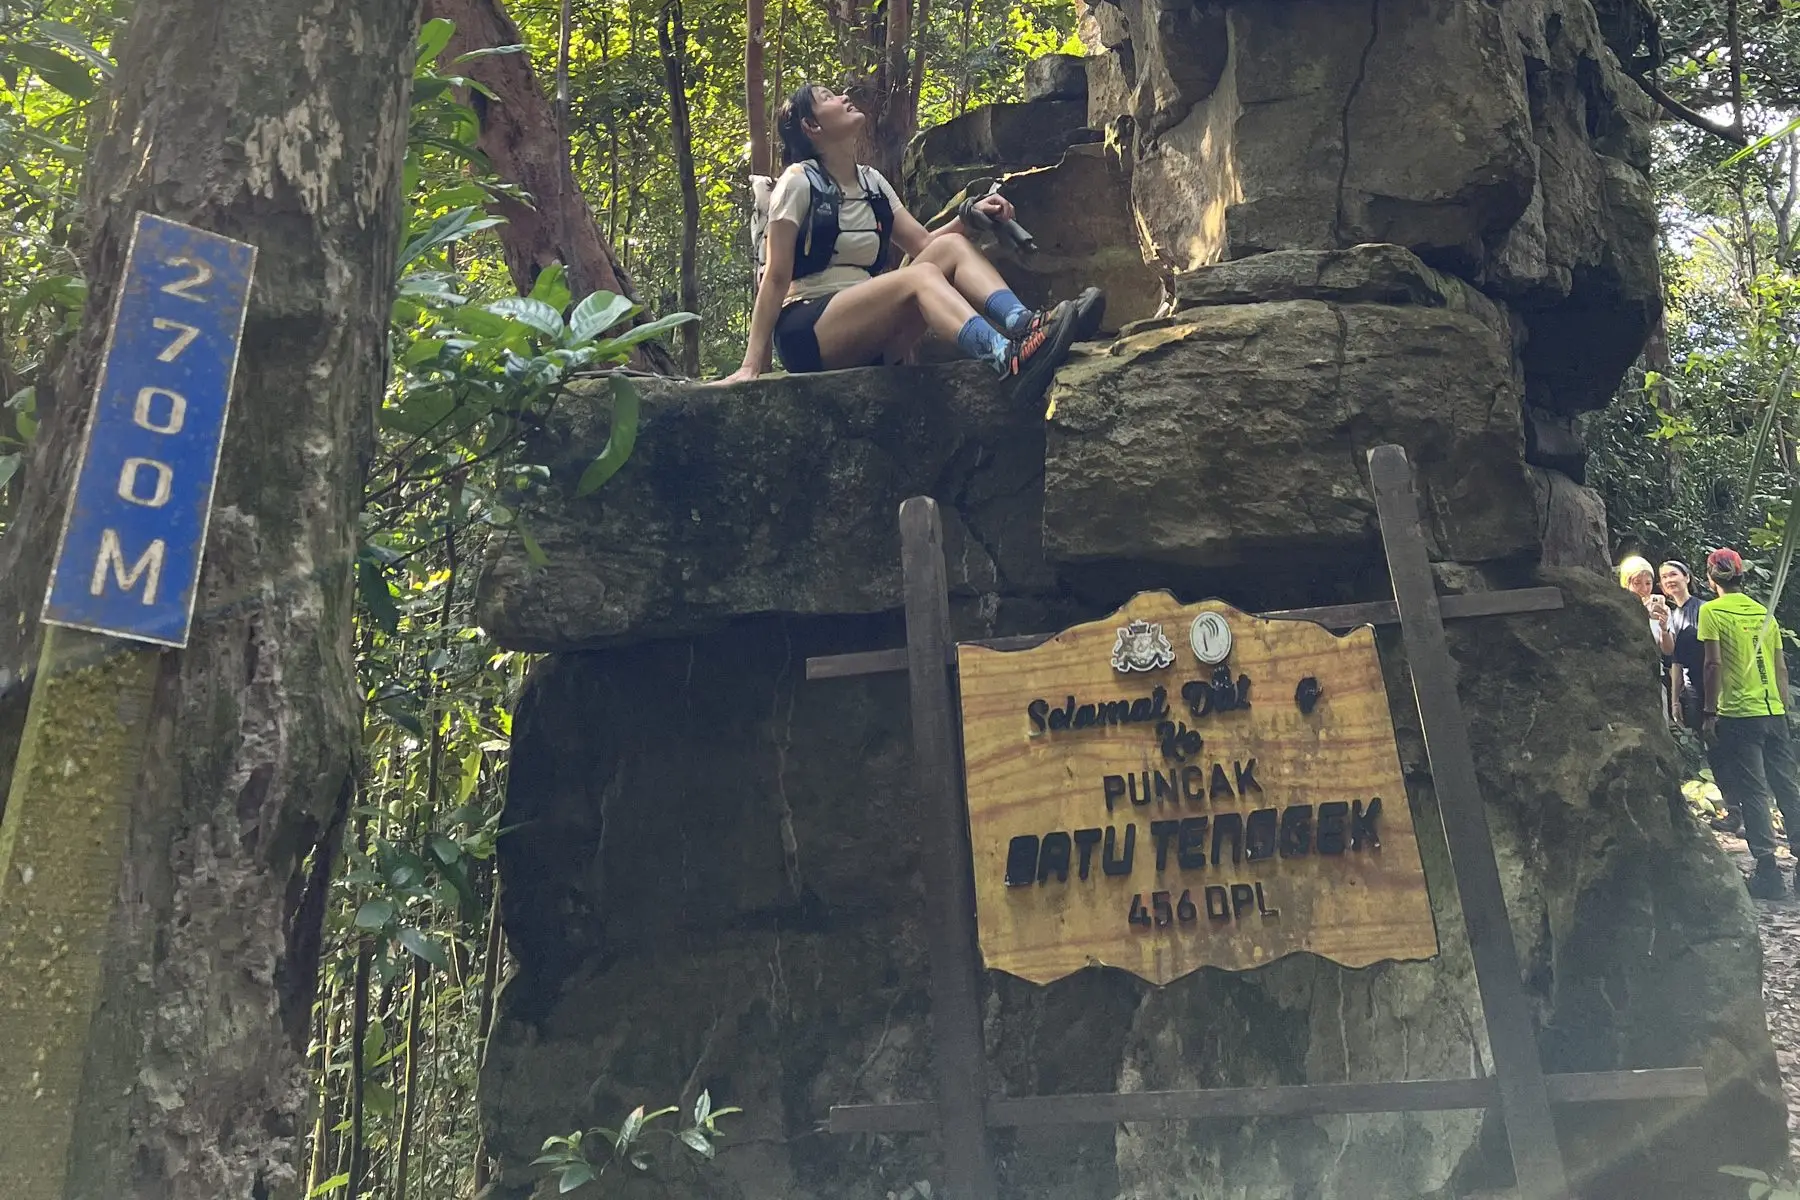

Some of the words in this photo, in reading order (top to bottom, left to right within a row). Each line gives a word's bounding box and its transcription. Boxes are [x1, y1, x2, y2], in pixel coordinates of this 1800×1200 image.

[1028, 684, 1171, 737] Selamat
[1103, 758, 1264, 812] PUNCAK
[1128, 888, 1198, 928] 456
[1205, 881, 1281, 924] DPL
